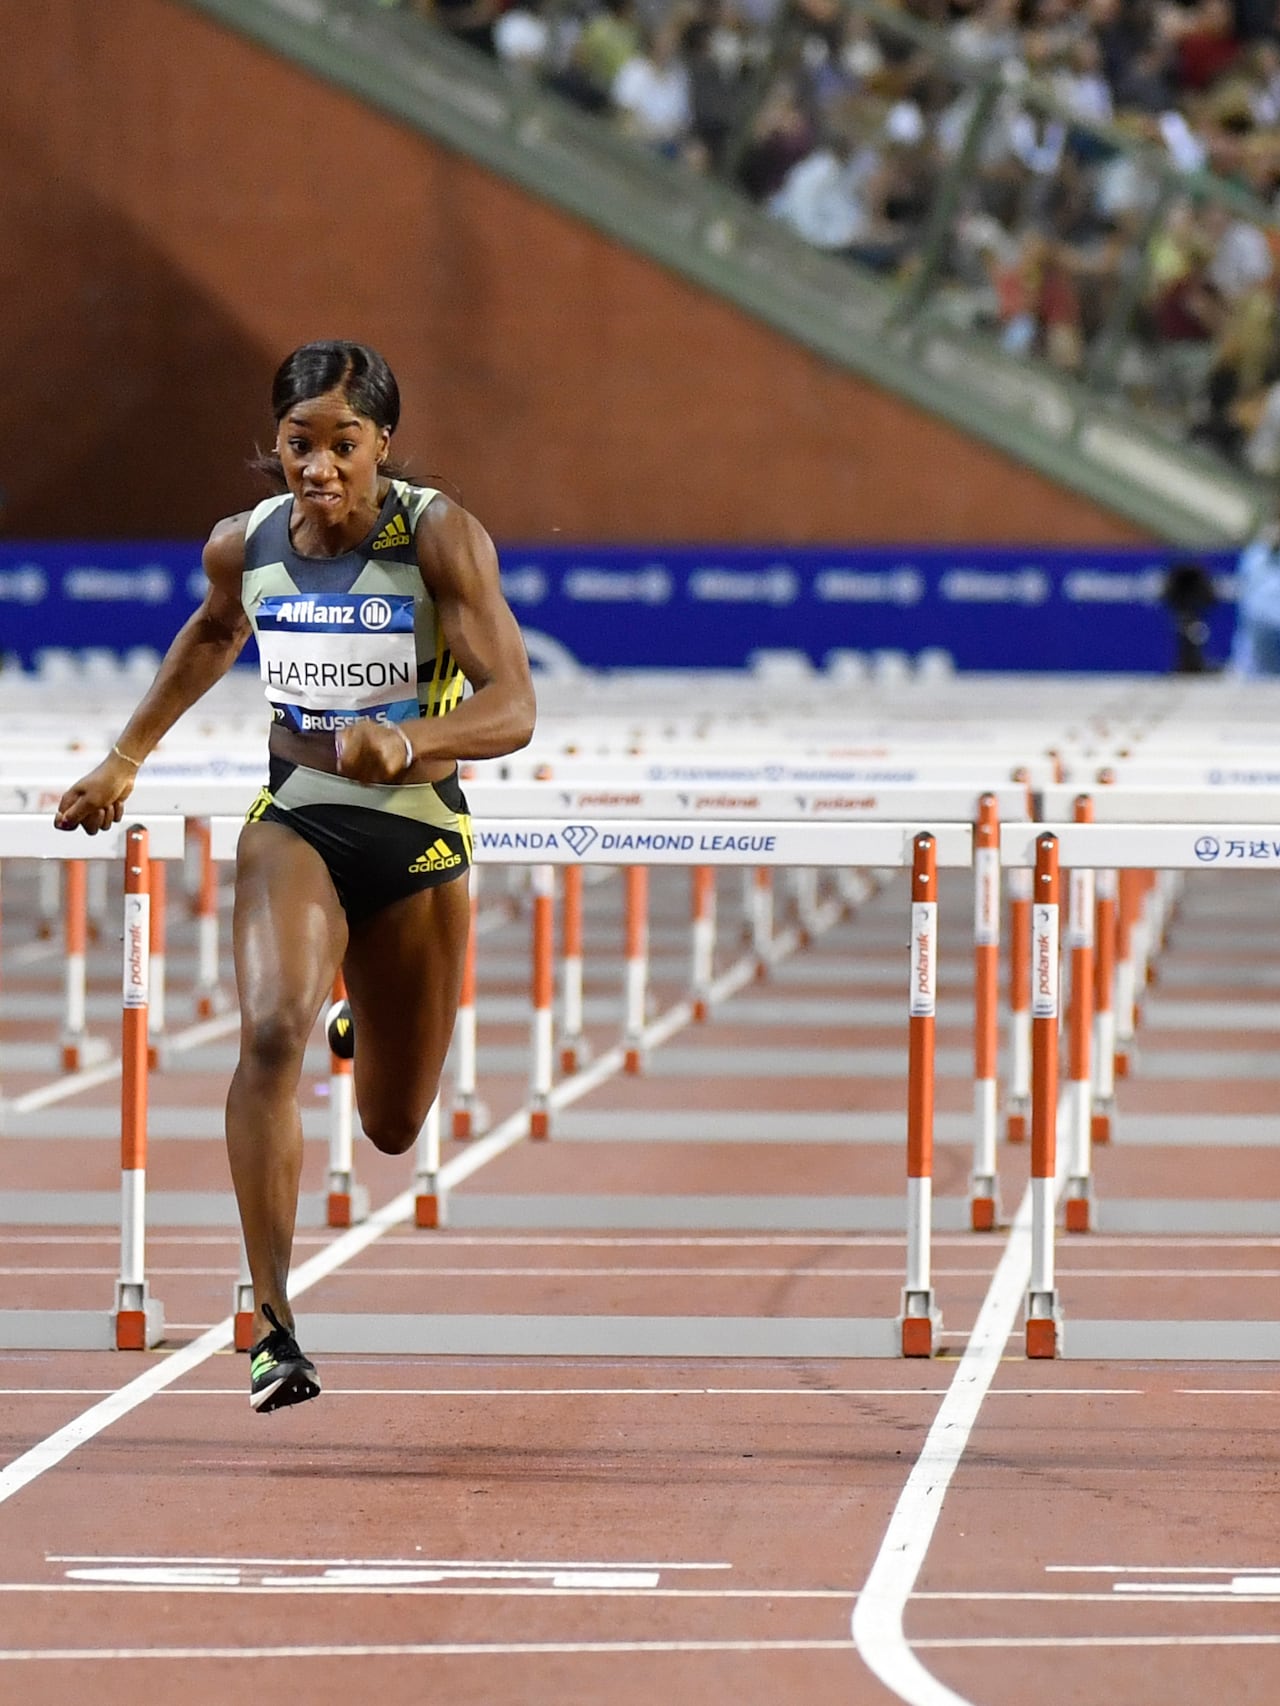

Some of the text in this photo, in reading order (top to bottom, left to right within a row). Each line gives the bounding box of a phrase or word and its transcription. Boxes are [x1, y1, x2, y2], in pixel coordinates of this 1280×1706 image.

[372, 534, 409, 551] adidas
[276, 601, 354, 624] Allianz
[268, 661, 410, 687] HARRISON
[473, 833, 776, 851] WANDA DIAMOND LEAGUE
[408, 854, 462, 873] adidas
[129, 924, 142, 986] polanik
[916, 933, 930, 994] polanik
[1038, 934, 1050, 995] polanik
